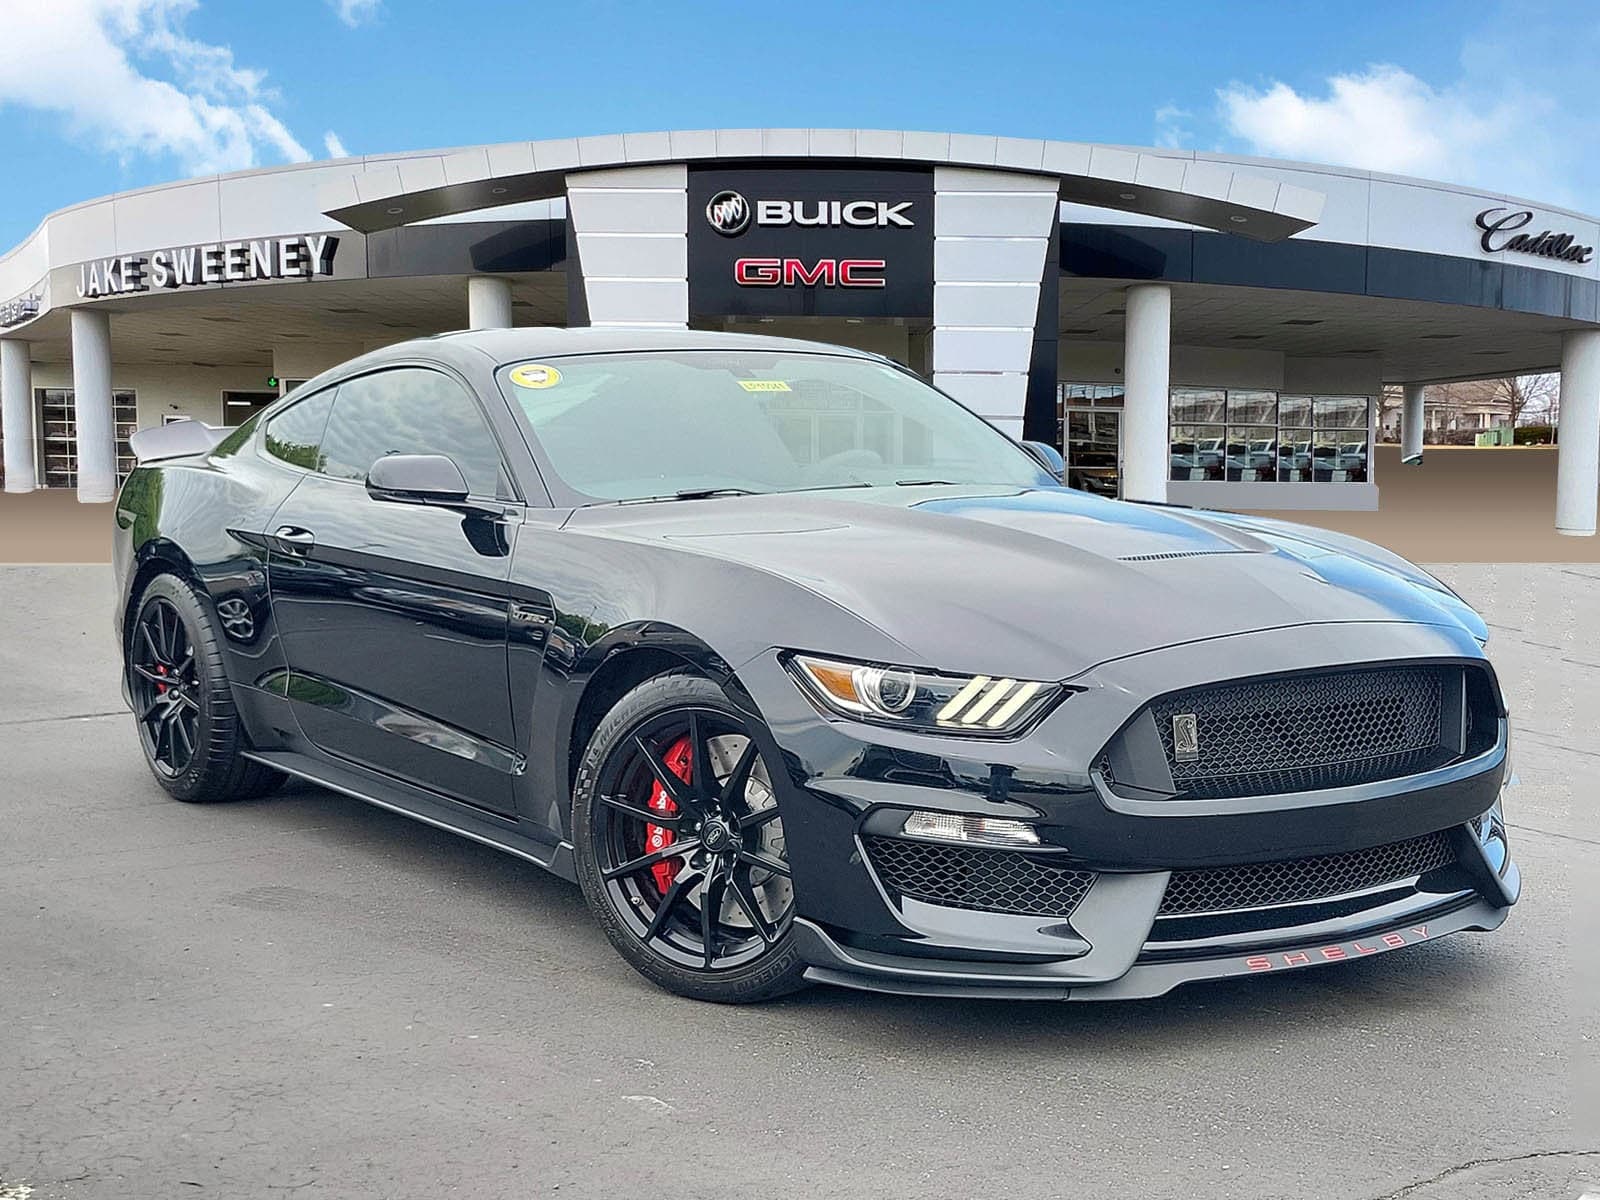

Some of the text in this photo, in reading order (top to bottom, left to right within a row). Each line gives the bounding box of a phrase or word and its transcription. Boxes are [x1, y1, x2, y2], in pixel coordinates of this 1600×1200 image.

[757, 200, 915, 226] BUICK
[1475, 207, 1594, 264] Cadillac
[76, 234, 330, 299] JAKE SWEENEY
[734, 258, 886, 287] GMC
[1246, 925, 1431, 971] SHELBY
